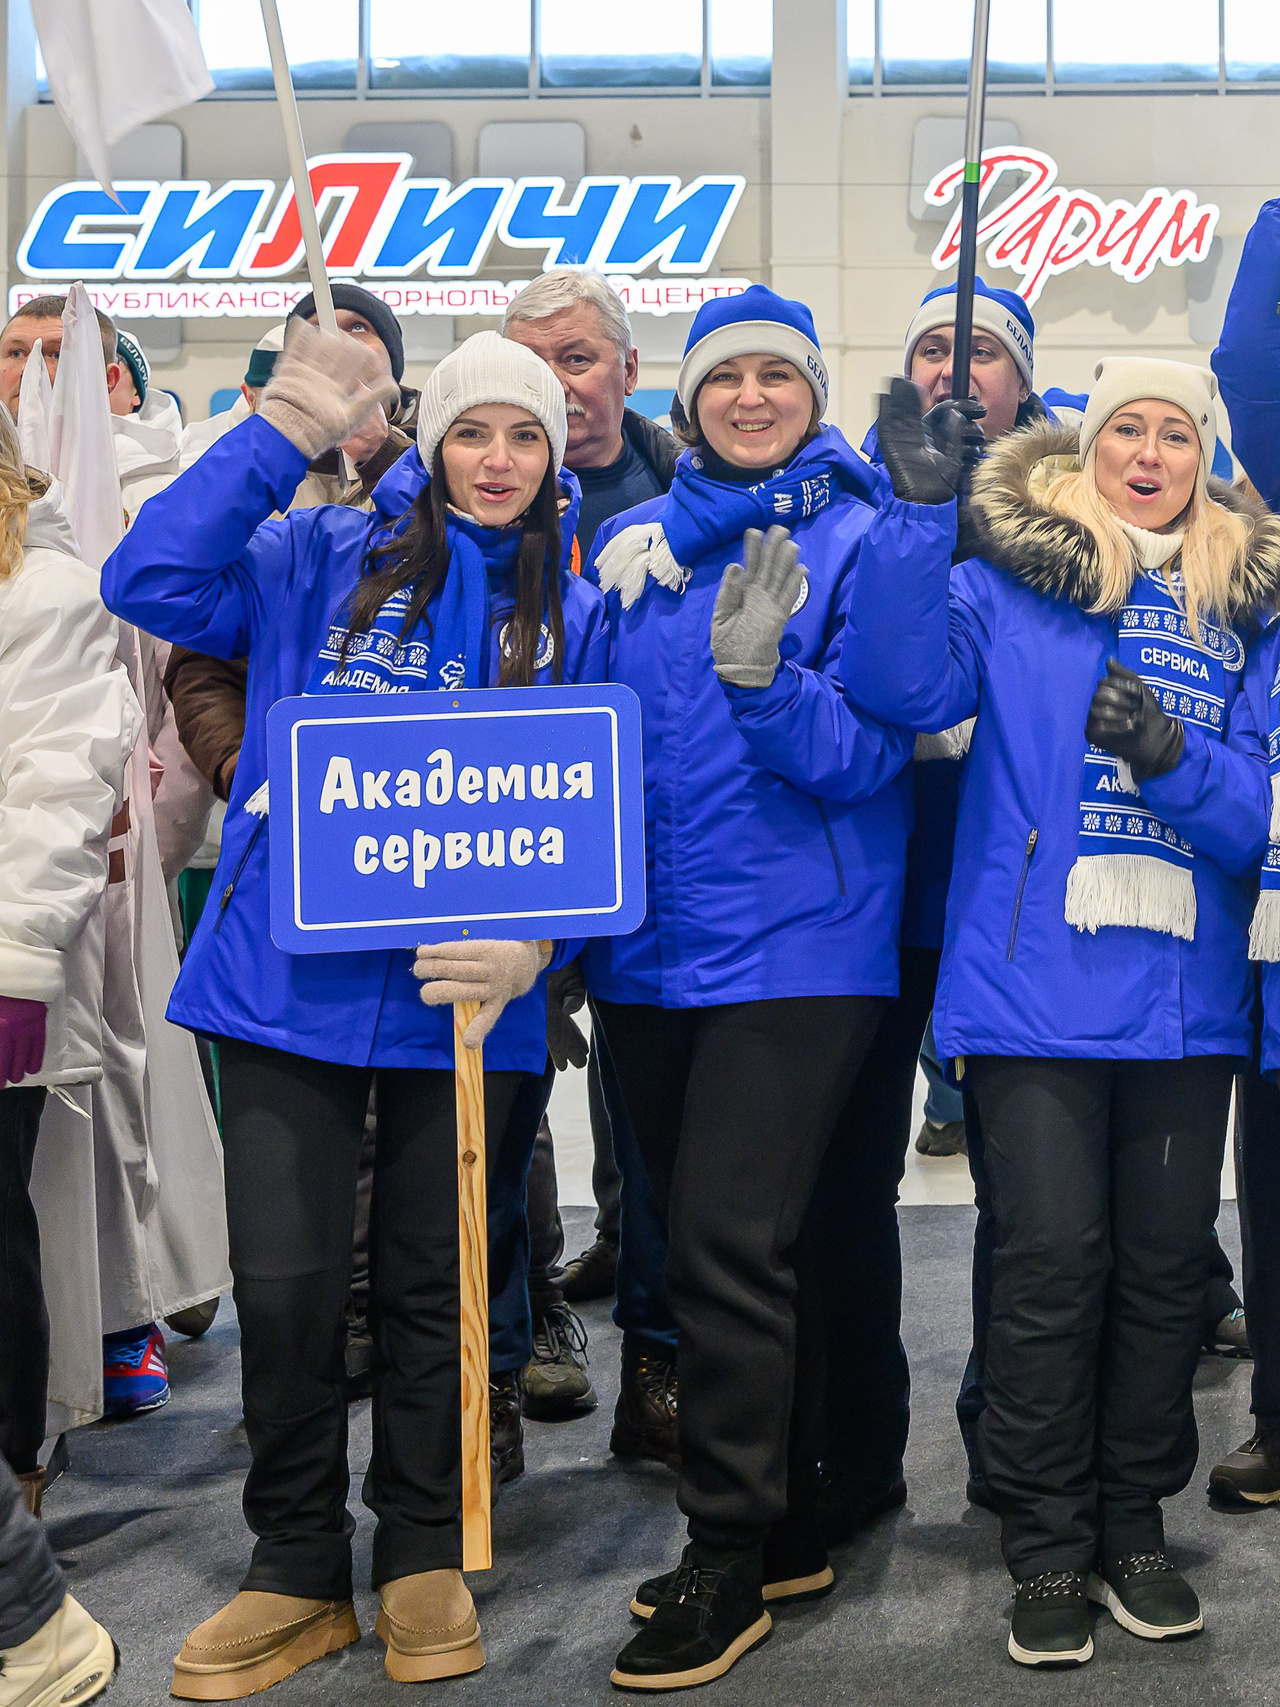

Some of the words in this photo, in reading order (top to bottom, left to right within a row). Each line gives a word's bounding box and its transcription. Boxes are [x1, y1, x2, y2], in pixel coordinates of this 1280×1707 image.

[932, 153, 1213, 303] Дарим
[1140, 647, 1210, 682] СЕРВИСА
[319, 748, 593, 814] Академия
[353, 826, 565, 889] сервиса
